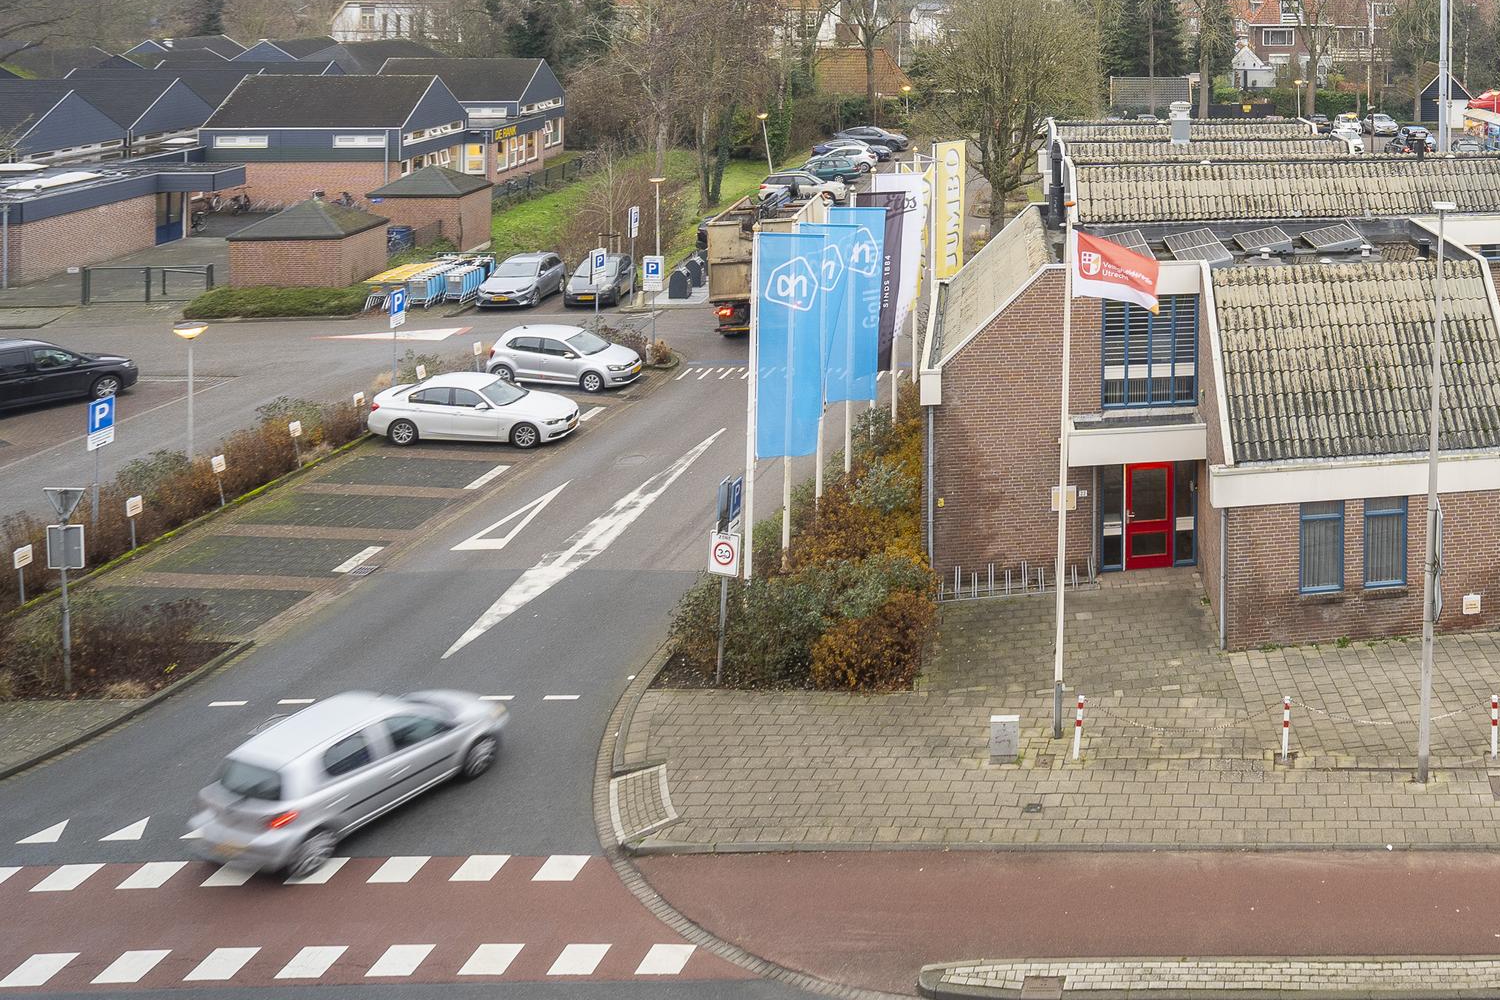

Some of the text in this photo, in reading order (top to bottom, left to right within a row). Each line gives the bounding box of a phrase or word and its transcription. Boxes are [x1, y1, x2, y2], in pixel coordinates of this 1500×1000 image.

[945, 148, 961, 268] JUMBO
[648, 264, 656, 274] P
[884, 254, 892, 276] 1884
[394, 292, 403, 312] P
[95, 403, 110, 429] P
